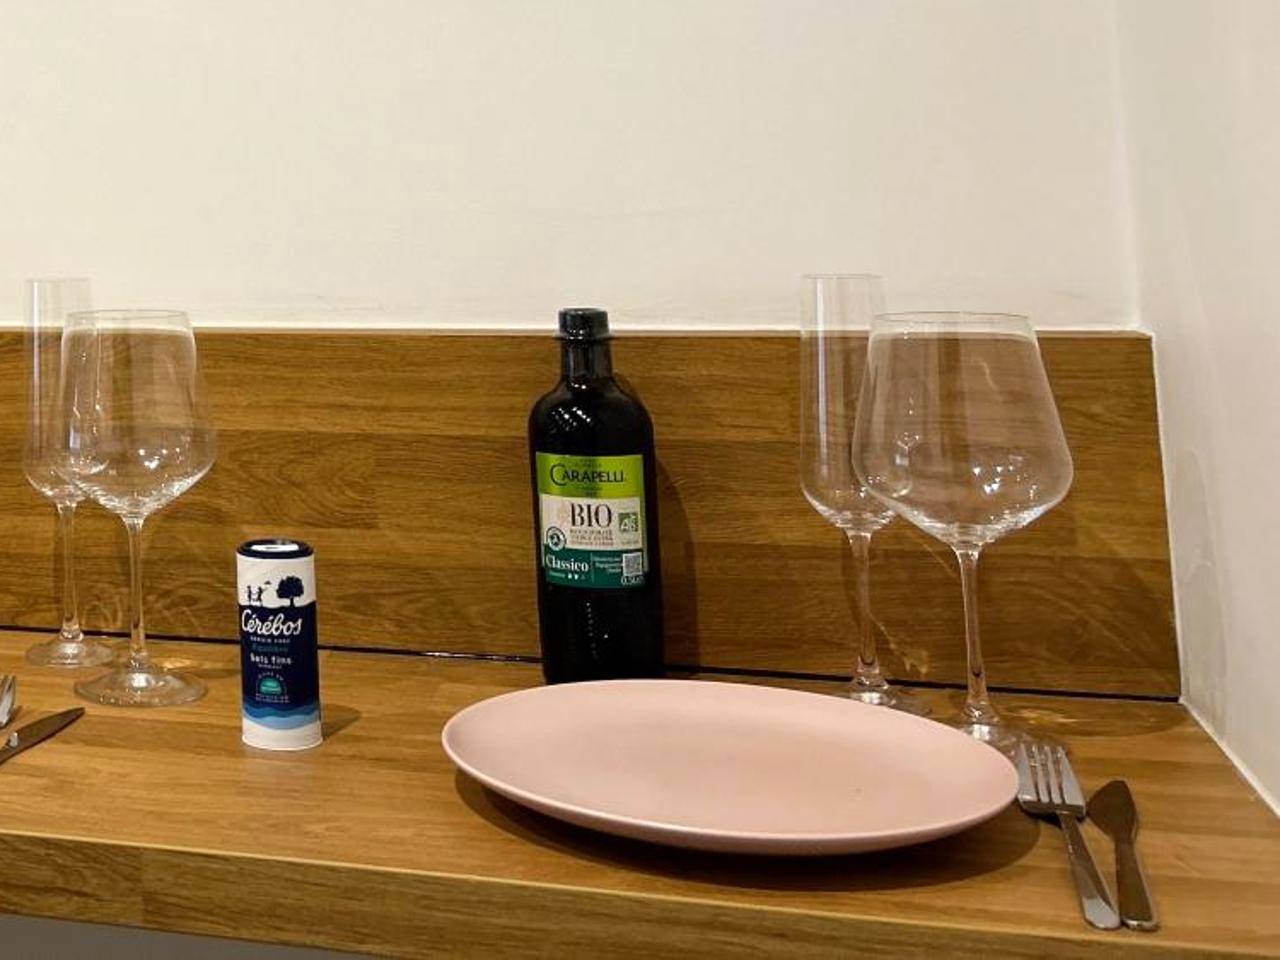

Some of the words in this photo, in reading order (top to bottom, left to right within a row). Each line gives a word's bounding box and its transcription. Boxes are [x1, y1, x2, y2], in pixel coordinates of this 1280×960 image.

[550, 462, 624, 486] CARAPELLI
[570, 503, 612, 528] BIO
[545, 554, 589, 572] Classico
[241, 609, 303, 636] Cérébos
